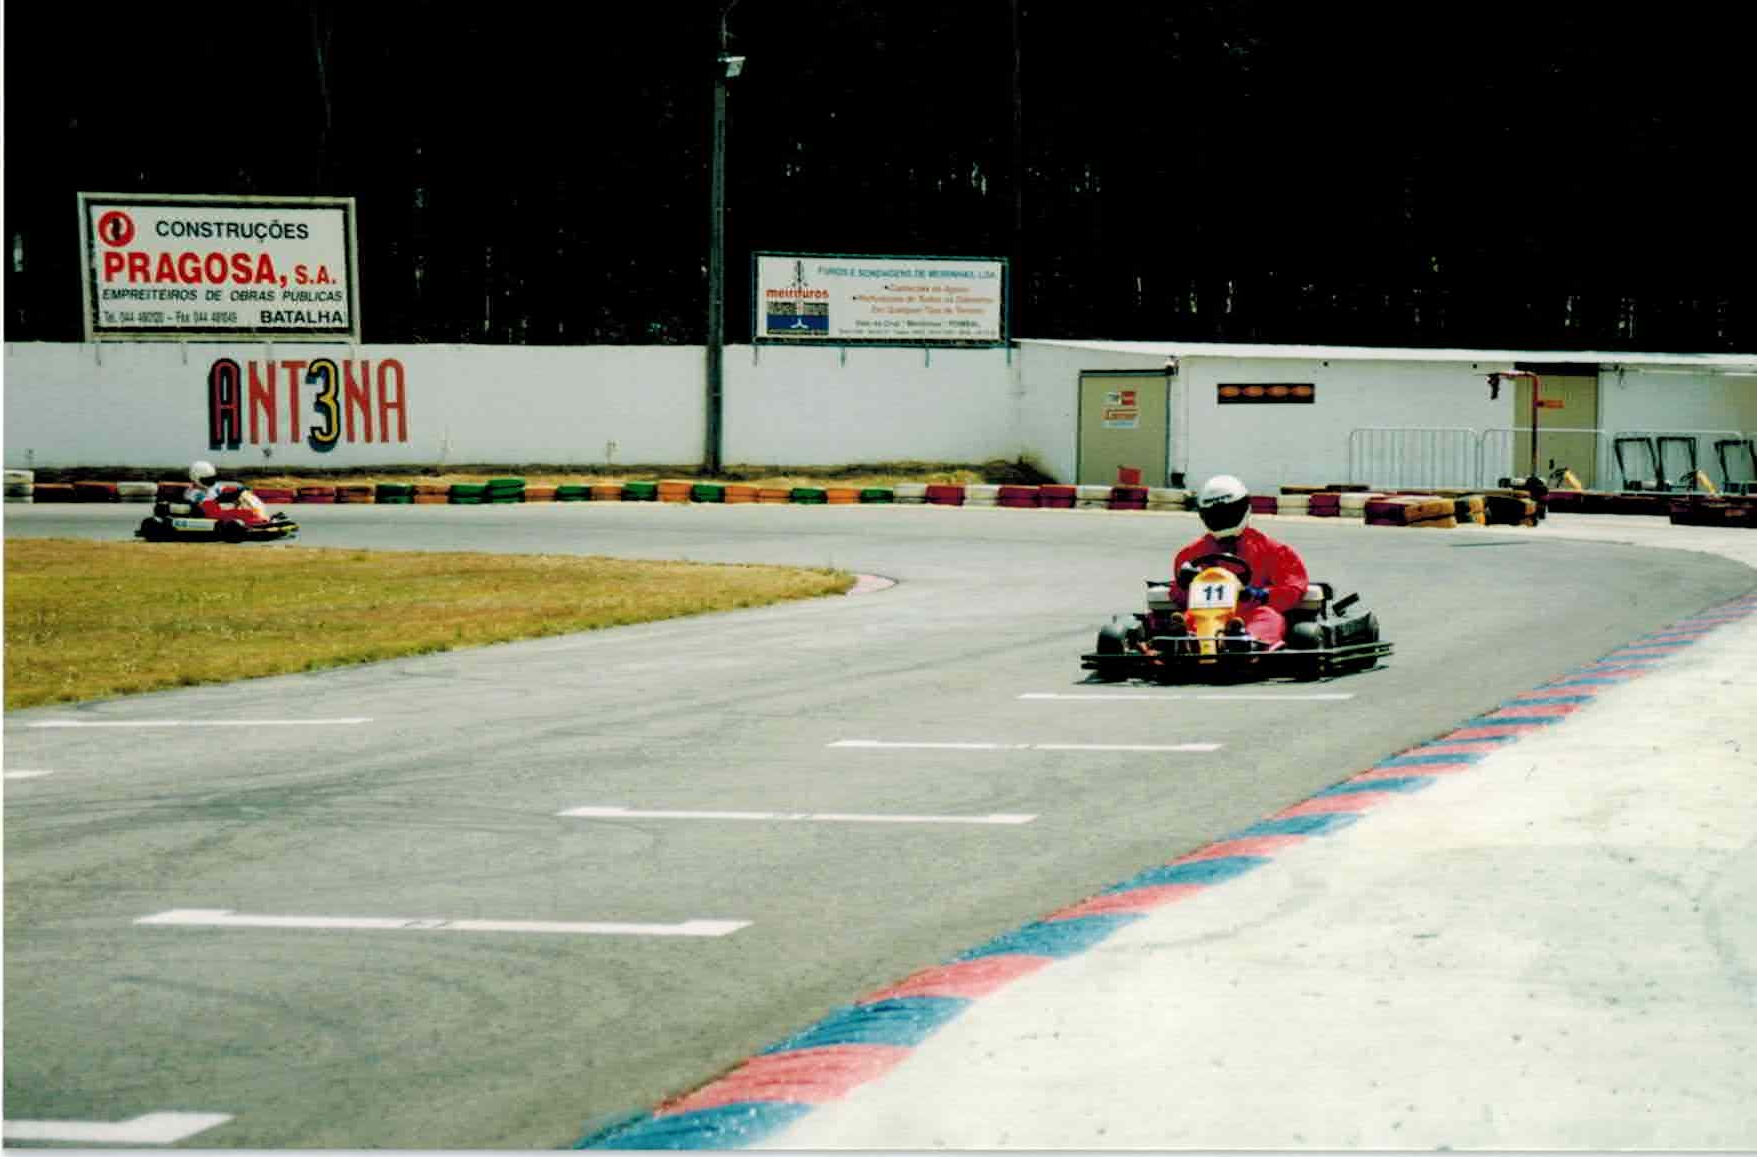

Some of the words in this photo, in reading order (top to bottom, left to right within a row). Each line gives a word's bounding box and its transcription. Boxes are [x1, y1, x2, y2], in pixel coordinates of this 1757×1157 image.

[156, 219, 309, 243] CONSTRUÇÕES
[103, 252, 287, 288] PRAGOSA,
[294, 265, 336, 285] S.A.
[103, 289, 198, 301] EMPREITEIROS
[205, 290, 222, 301] DE
[230, 290, 275, 301] OBRAS
[260, 310, 342, 324] BATALHA
[208, 358, 408, 453] ANT3NA
[1203, 584, 1224, 601] 11
